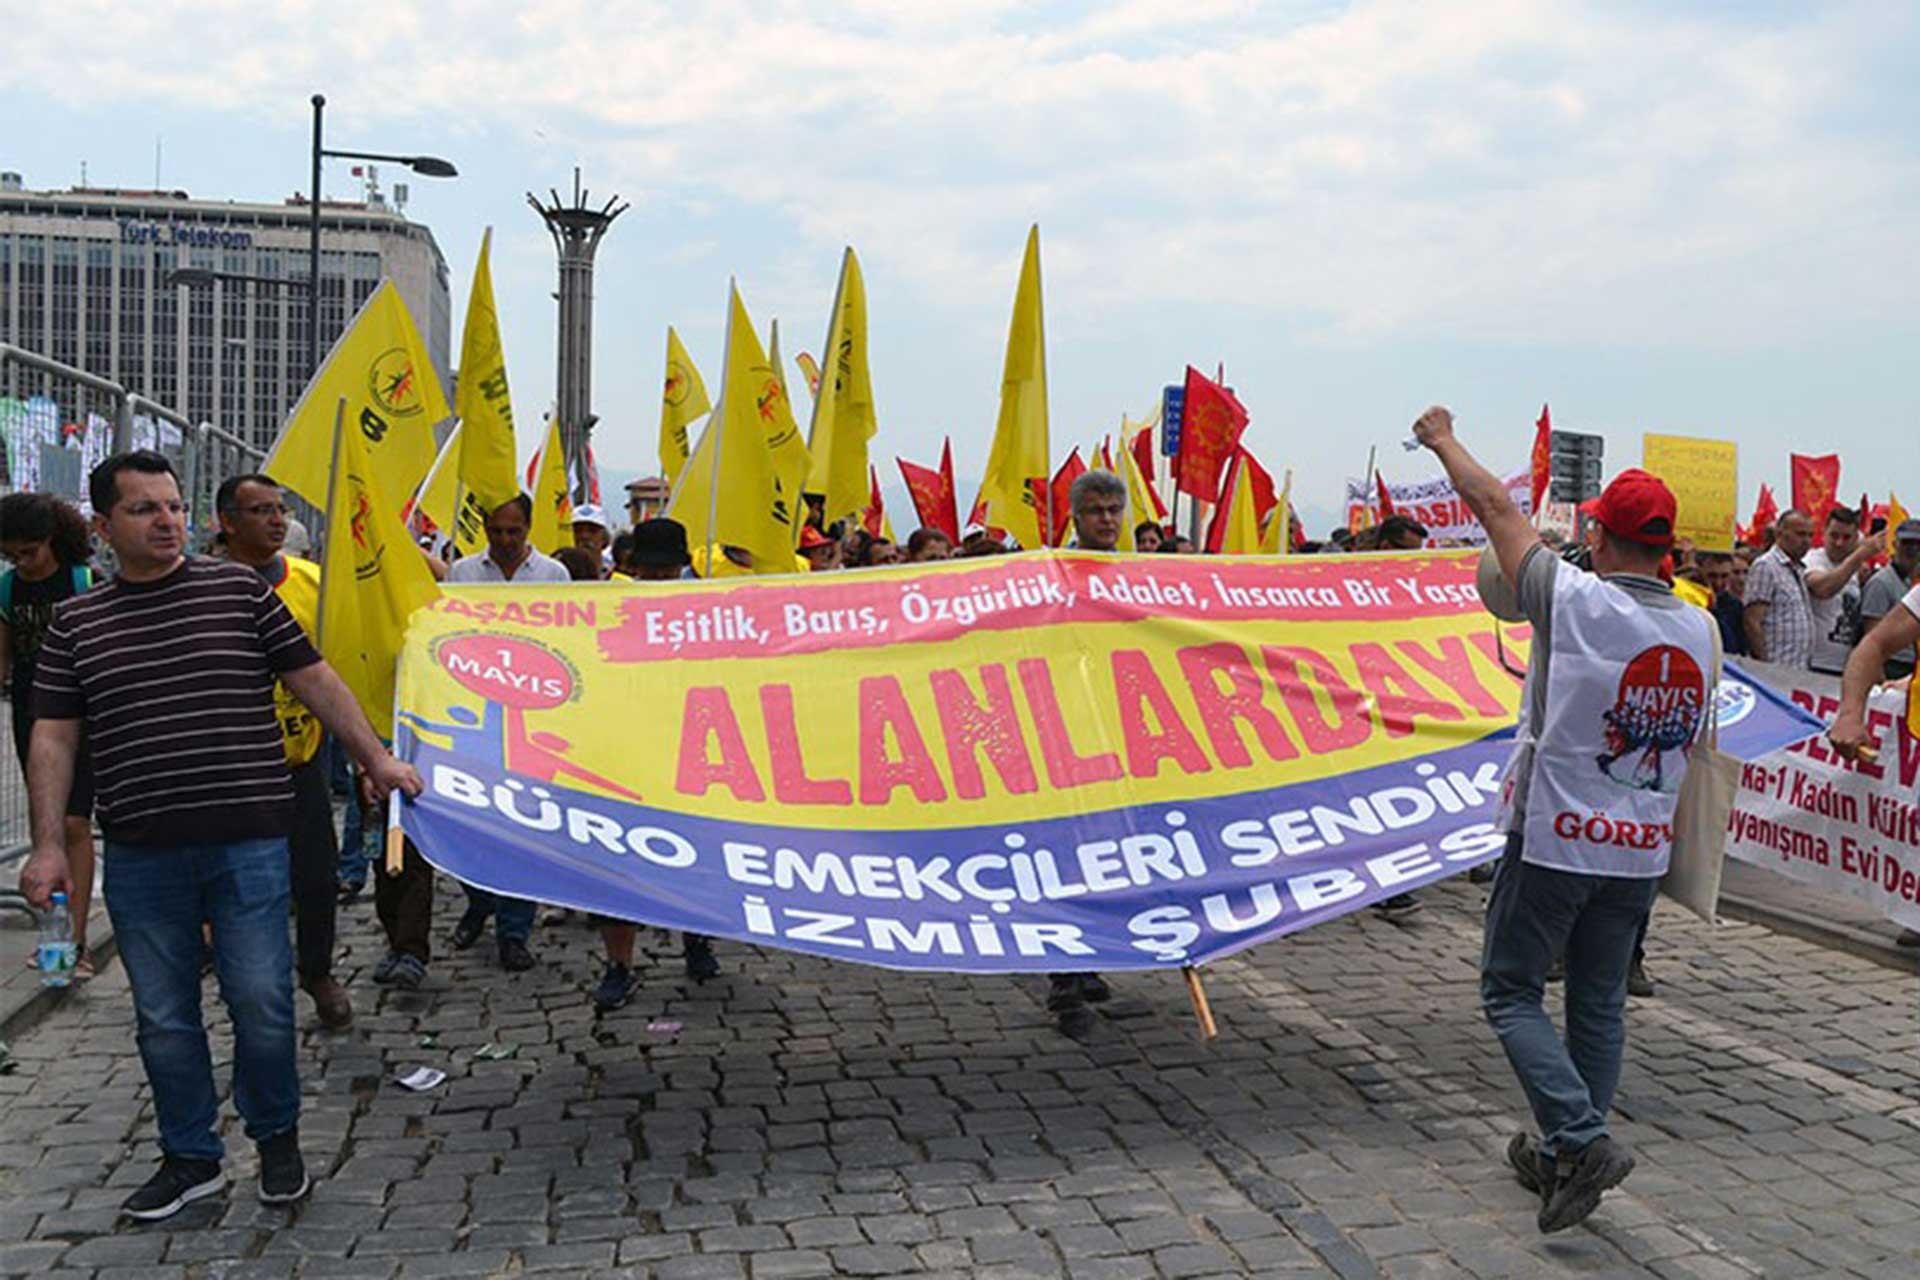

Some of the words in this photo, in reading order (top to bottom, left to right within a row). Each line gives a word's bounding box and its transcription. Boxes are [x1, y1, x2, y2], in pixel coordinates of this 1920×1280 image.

[117, 217, 161, 241] Türk
[169, 222, 252, 246] Telekom
[427, 598, 597, 628] AŞASIN
[646, 605, 769, 650] Eşitlik,
[784, 603, 888, 637] Barış,
[900, 575, 1076, 626] Özgürlük,
[1088, 574, 1210, 610] Adalet,
[1211, 574, 1338, 609] İnsanca
[1346, 579, 1391, 607] Bir
[448, 653, 563, 698] MAYIS
[497, 649, 512, 669] 1
[1660, 652, 1671, 683] 1
[675, 623, 1534, 806] ALANLARDAYI
[1624, 685, 1698, 712] MAYIS
[1789, 769, 1859, 824] Kadın
[432, 764, 698, 869] BÜRO
[722, 810, 1207, 914] EMEKÇİLERİ
[1840, 835, 1879, 883] Evi
[742, 894, 1098, 957] İZMİR
